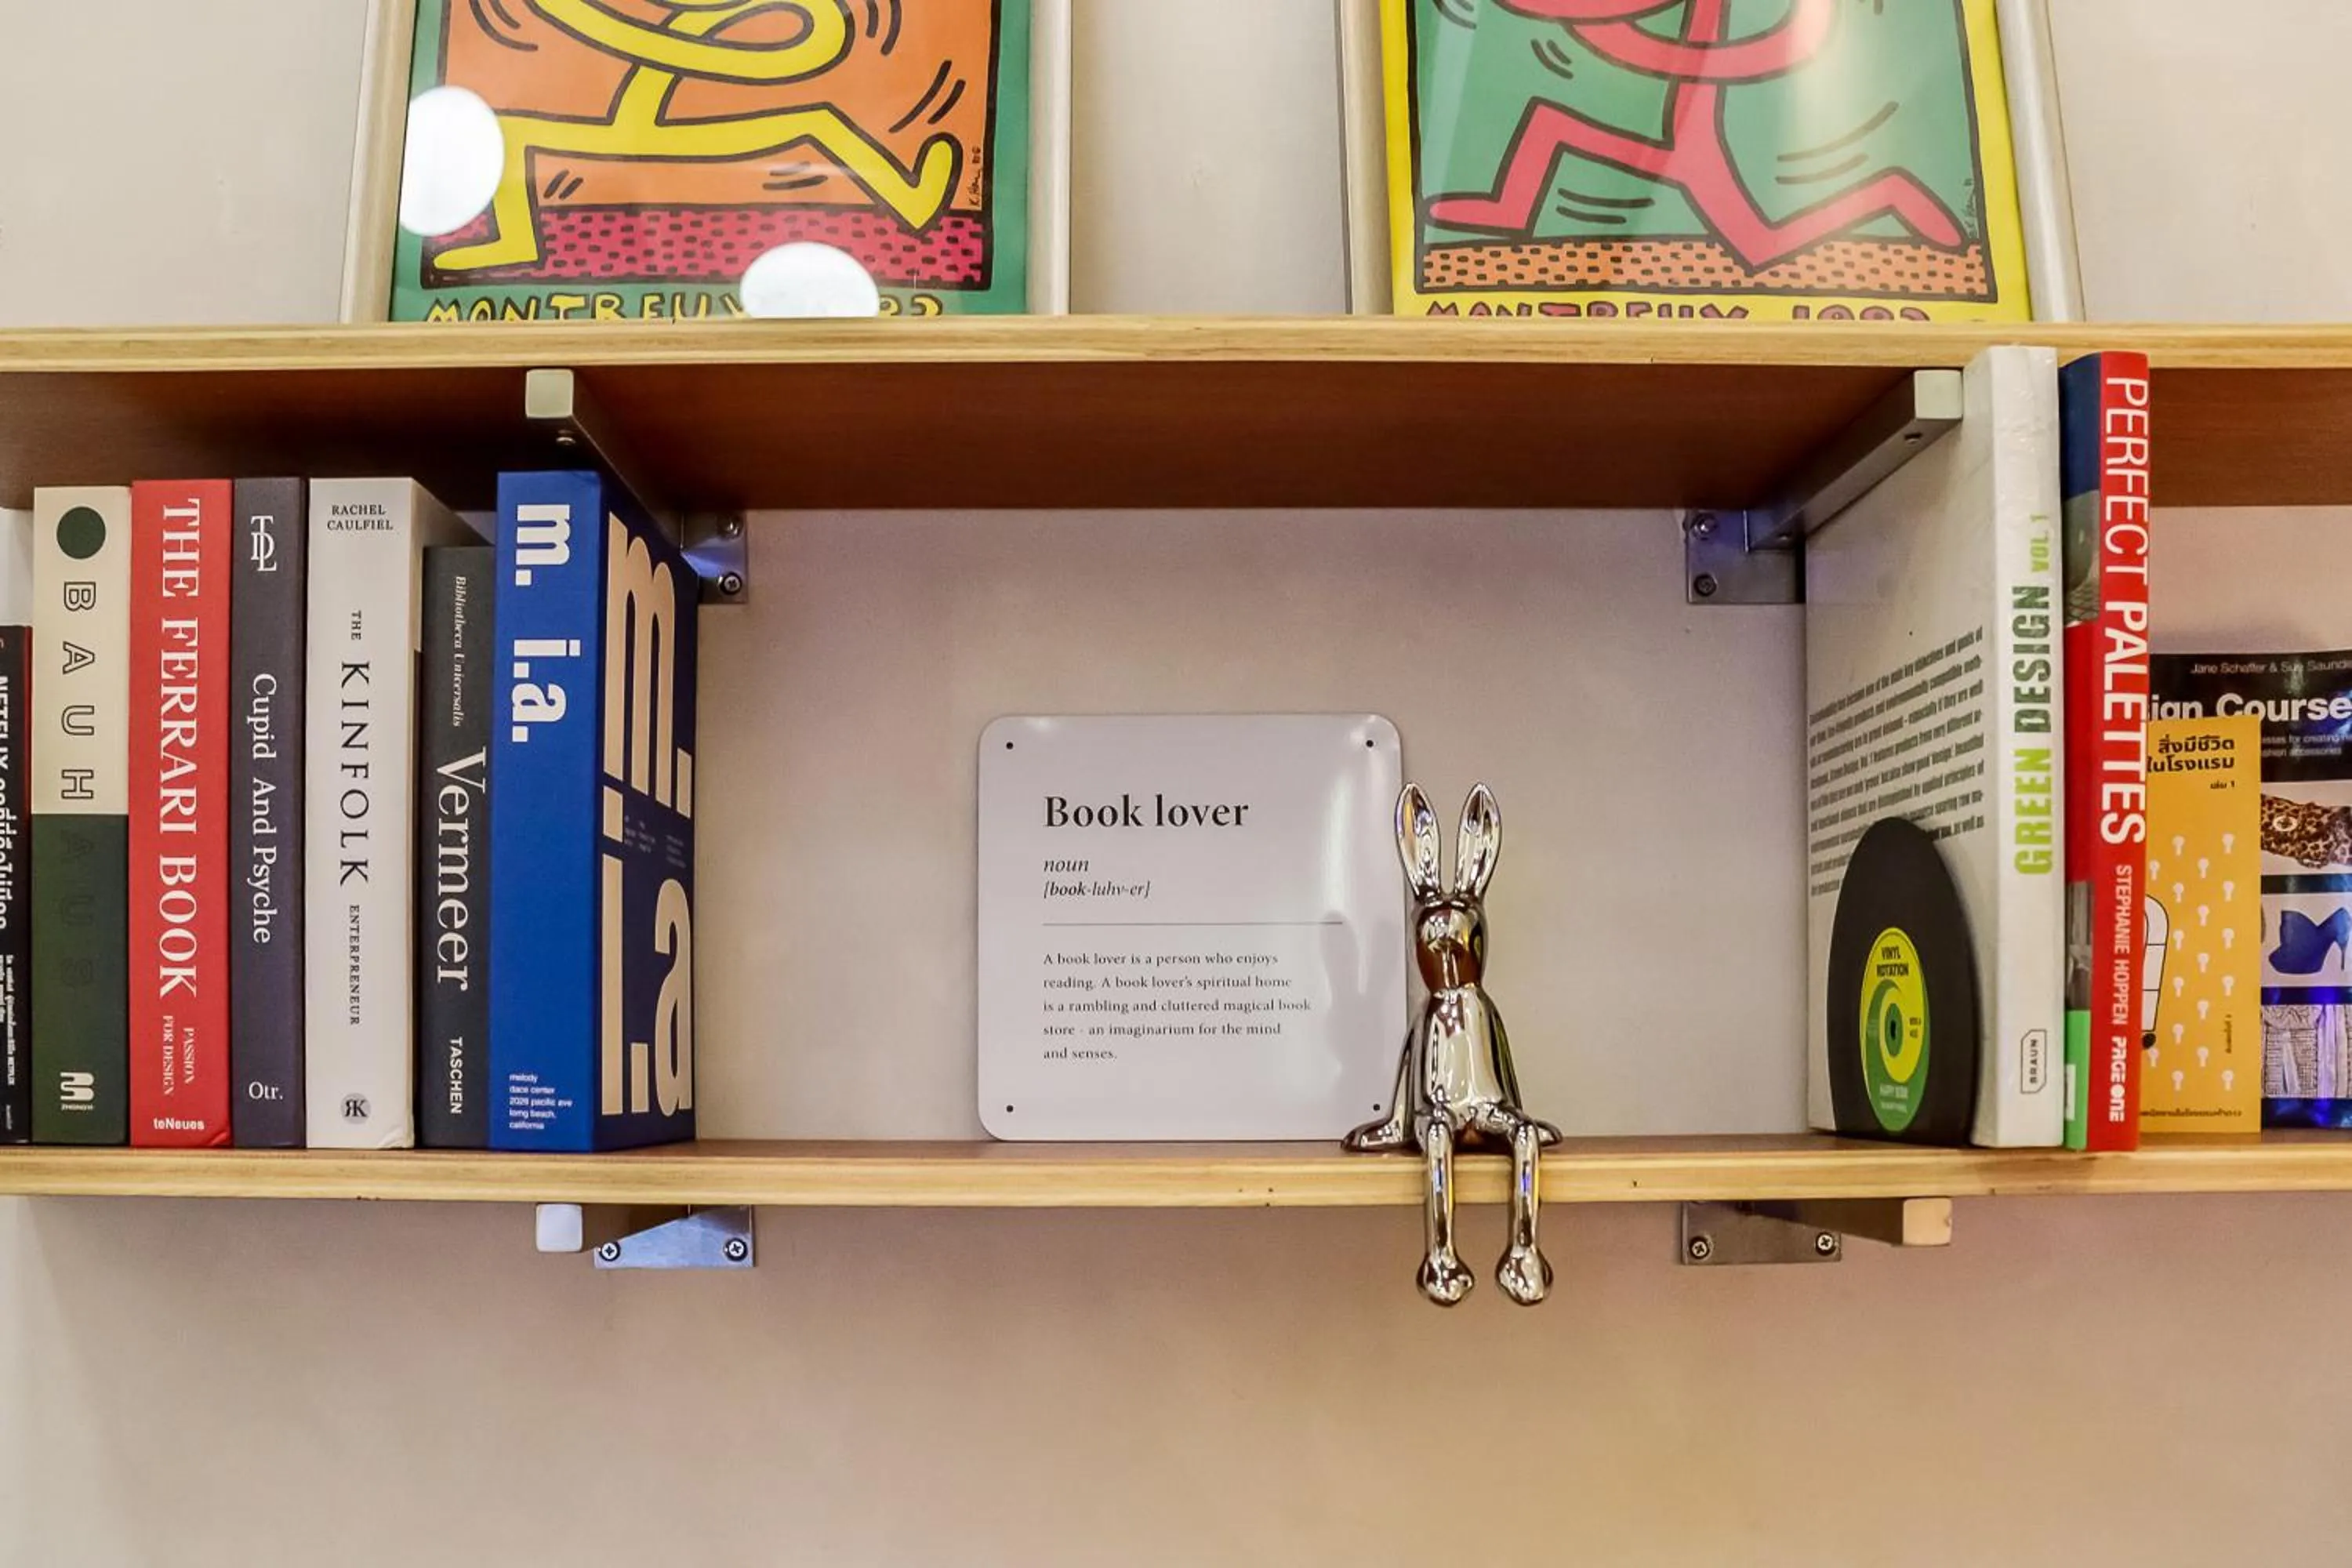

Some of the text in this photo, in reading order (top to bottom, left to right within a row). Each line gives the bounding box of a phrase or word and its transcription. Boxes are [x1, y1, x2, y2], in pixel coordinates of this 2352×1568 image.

[332, 504, 387, 515] RACHEL
[350, 611, 361, 641] THE
[453, 576, 467, 649] Bibliotheca
[2100, 377, 2149, 844] PERFECT PALETTES
[2011, 586, 2052, 733] DESIGN
[159, 498, 201, 997] THE FERRARI BOOK
[339, 662, 370, 886] KINFOLK
[247, 673, 278, 943] Cupid And Psyche
[1044, 792, 1249, 827] Book lover
[2013, 748, 2053, 875] GREEN
[437, 746, 487, 991] Vermeer
[1044, 858, 1090, 873] noun
[2114, 865, 2133, 955] STEPHANIE
[1044, 953, 1054, 965] A
[1058, 953, 1091, 965] book
[1094, 953, 1127, 965] lover
[1131, 953, 1142, 965] is
[1156, 956, 1200, 967] person
[1205, 953, 1233, 964] who
[1236, 955, 1279, 967] enjoys
[1044, 977, 1097, 991] reading.
[1102, 978, 1112, 989] A
[1116, 976, 1148, 989] book
[1196, 976, 1251, 991] spiritual
[1255, 977, 1292, 988] home
[2111, 959, 2130, 1025] HOPPEN
[1044, 1001, 1054, 1012] is
[1069, 1000, 1129, 1014] rambling
[1133, 1000, 1157, 1012] and
[1161, 1000, 1219, 1012] cluttered
[1224, 999, 1275, 1014] magical
[1279, 999, 1312, 1011] book
[1044, 1025, 1076, 1036] store
[1109, 1024, 1194, 1038] imaginarium
[1199, 1023, 1217, 1035] for
[1221, 1023, 1243, 1035] the
[1246, 1023, 1281, 1035] mind
[162, 1015, 174, 1095] FOR DESIGN
[183, 1028, 195, 1084] PASSION
[450, 1036, 463, 1114] TASCHEN
[1044, 1047, 1117, 1060] and senses.
[2030, 1039, 2038, 1084] BRAUN
